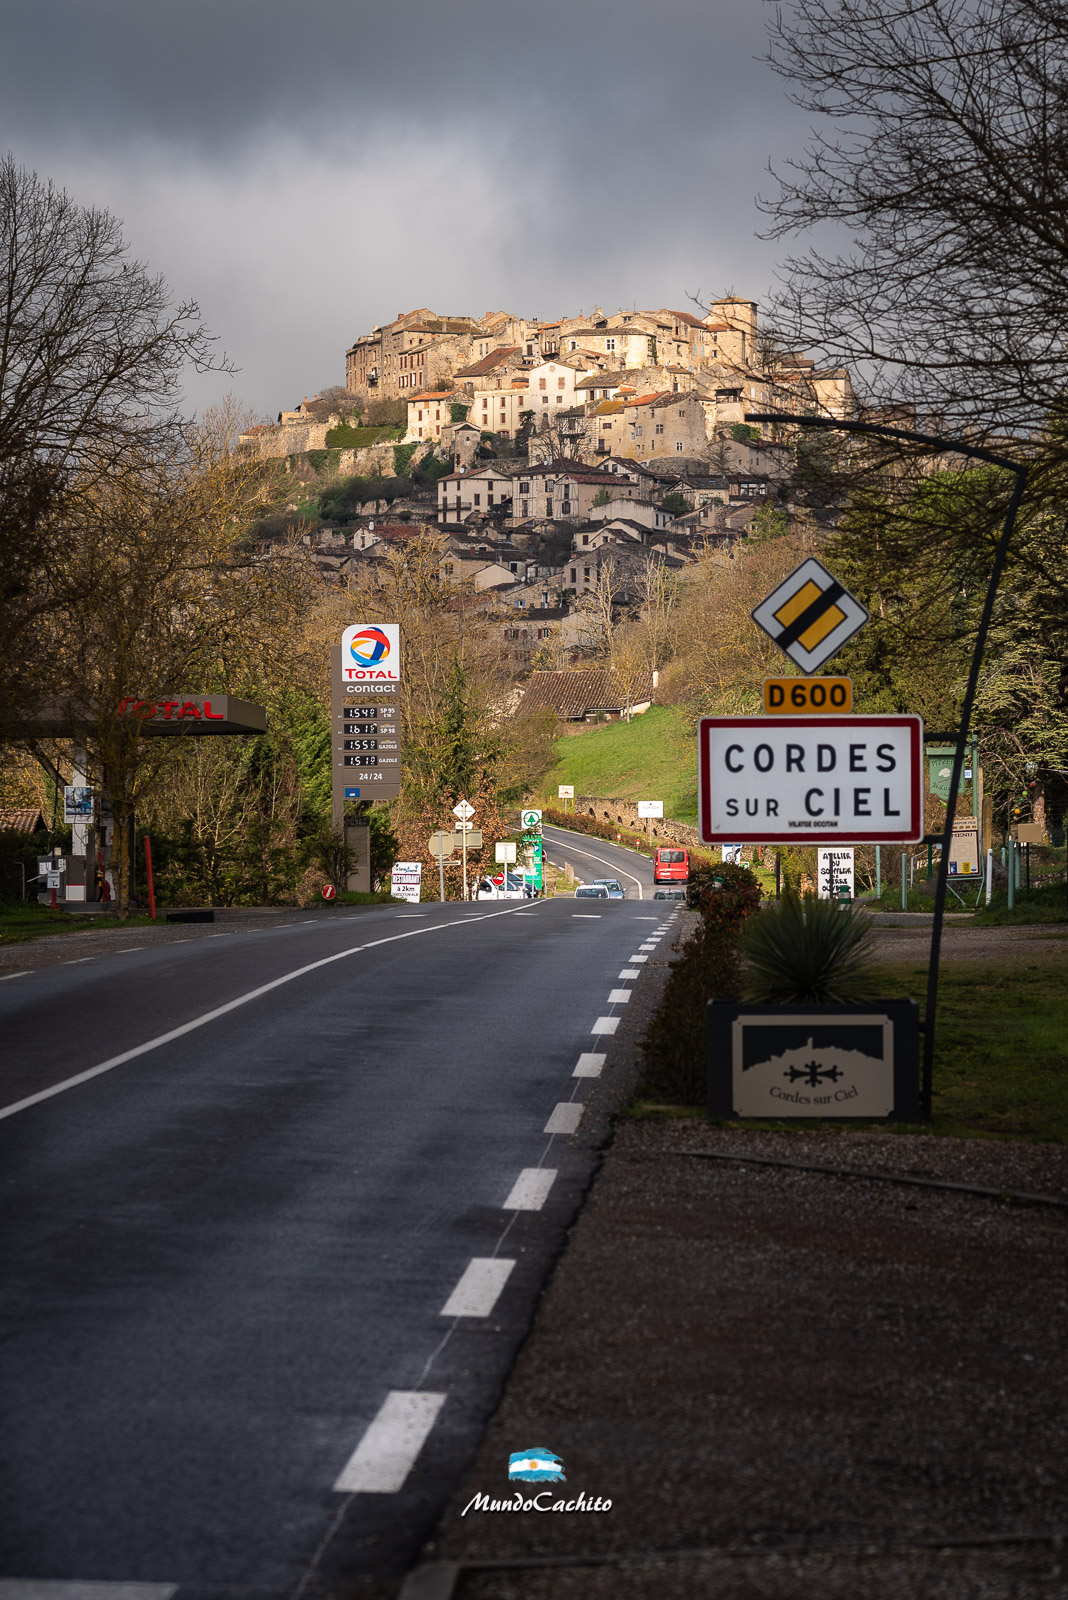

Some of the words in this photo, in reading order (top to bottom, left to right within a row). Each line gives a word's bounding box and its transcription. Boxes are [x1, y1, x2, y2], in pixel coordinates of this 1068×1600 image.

[345, 668, 397, 679] TOTAL
[346, 684, 396, 693] contact
[725, 743, 897, 773] CORDES
[725, 798, 780, 817] SUR
[804, 787, 901, 817] CIEL
[769, 1086, 812, 1105] Cordes
[813, 1094, 832, 1105] sur
[834, 1085, 859, 1103] Ciel
